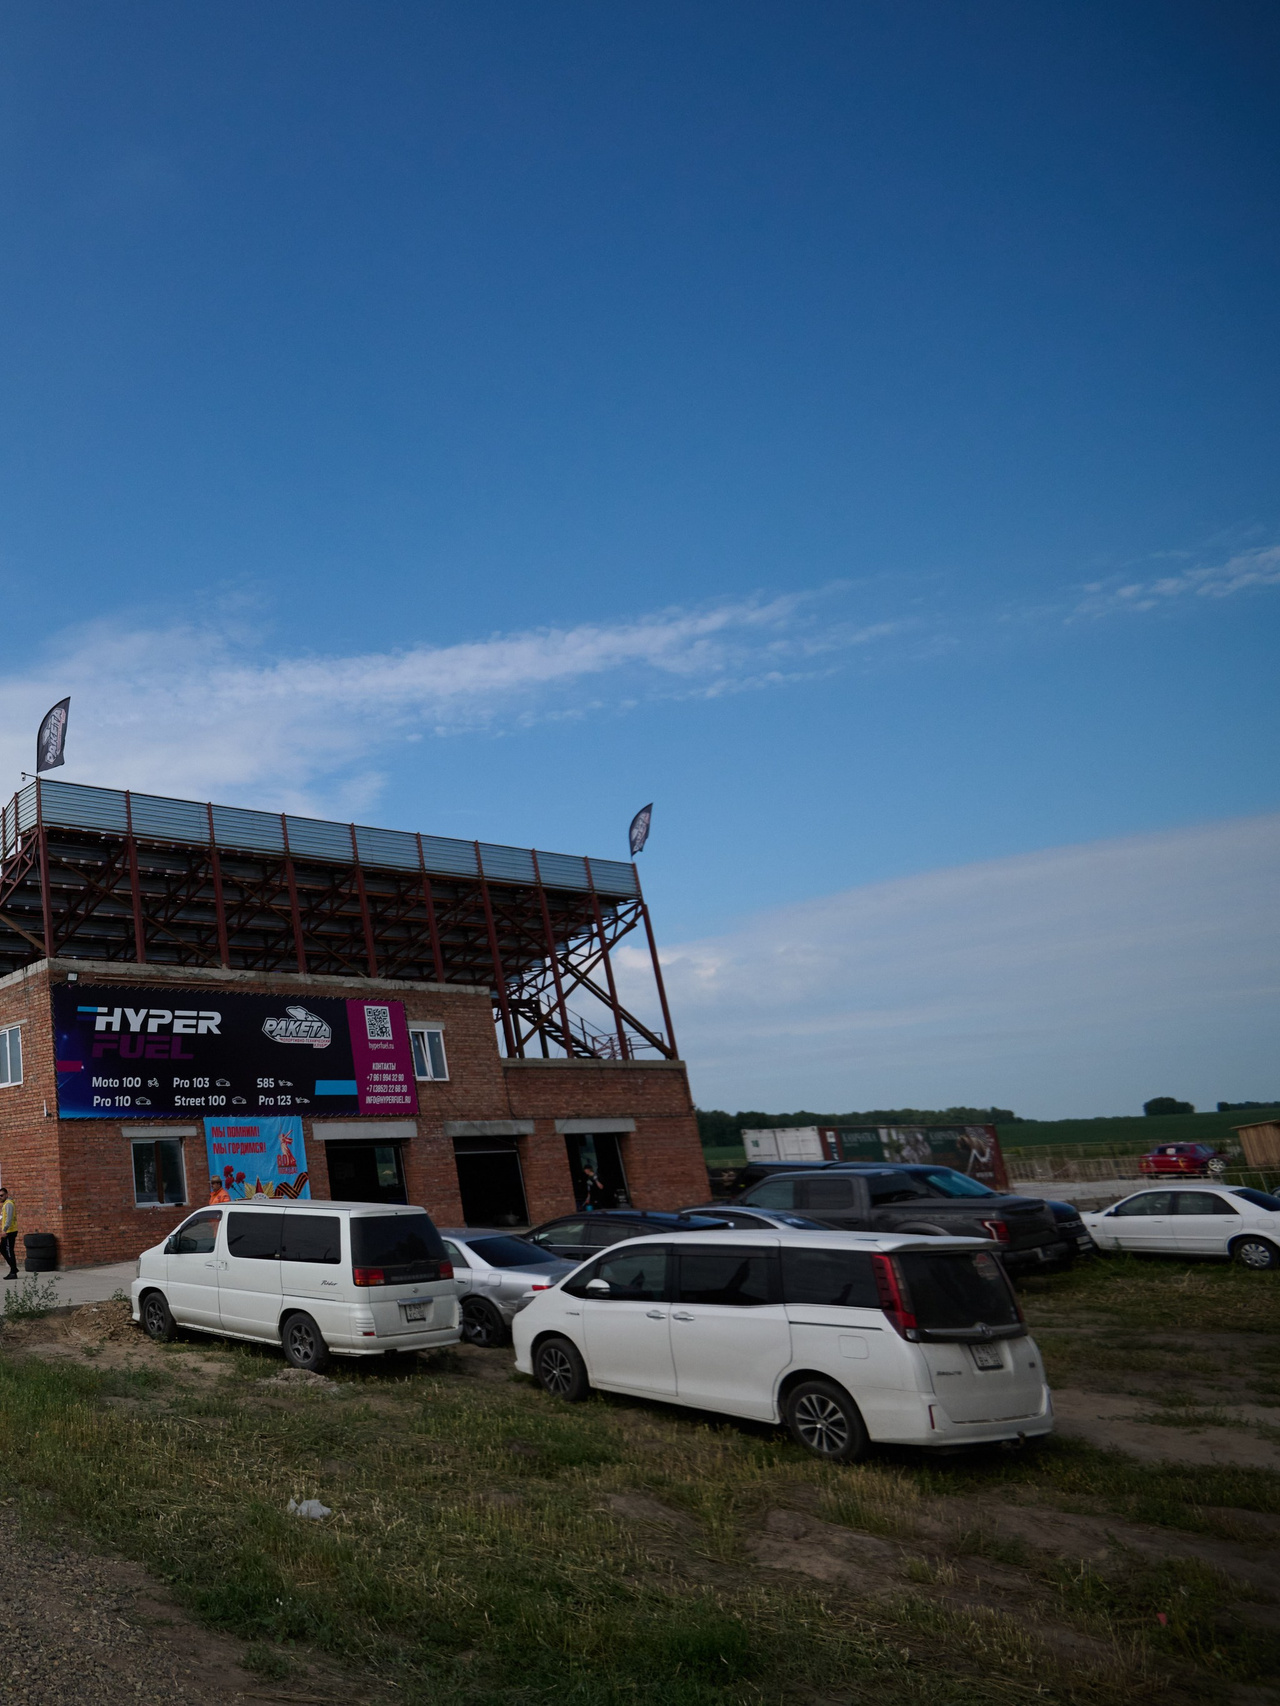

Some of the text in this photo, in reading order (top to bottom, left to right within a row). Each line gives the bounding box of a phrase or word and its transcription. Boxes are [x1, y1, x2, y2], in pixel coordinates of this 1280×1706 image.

[94, 1007, 222, 1035] HYPER
[263, 1019, 330, 1038] РАКЕТА
[92, 1034, 195, 1060] FUEL
[368, 1042, 395, 1051] hyperfuel.ru
[372, 1062, 397, 1070] КОНТАКТЫ
[92, 1077, 142, 1088] Moto 100
[173, 1077, 210, 1088] Pro 103
[256, 1077, 275, 1088] S85
[367, 1073, 372, 1081] +7
[93, 1096, 131, 1107] Pro 110
[174, 1095, 226, 1106] Street 100
[258, 1095, 292, 1106] Pro 123
[366, 1096, 411, 1104] INFO@HYPERFUEL.RU
[211, 1126, 260, 1138] МЫ ПОМНИМ!
[213, 1142, 267, 1155] МЫ ГОРДИМСЯ!
